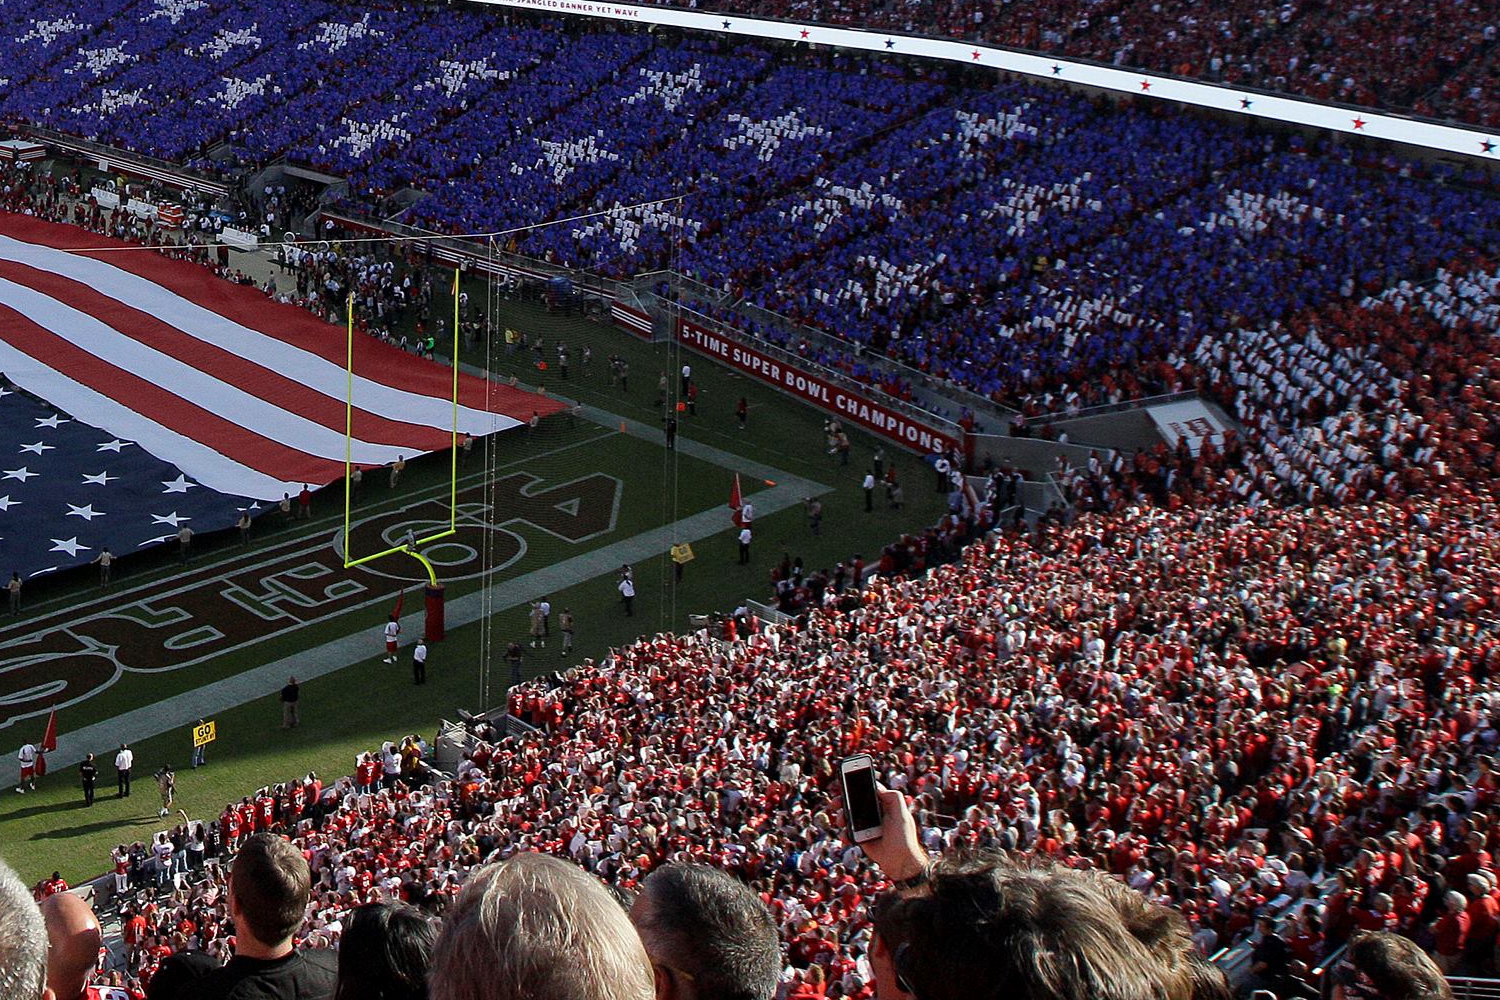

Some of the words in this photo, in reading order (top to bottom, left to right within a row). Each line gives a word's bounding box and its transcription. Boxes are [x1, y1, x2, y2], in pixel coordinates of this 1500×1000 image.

[560, 1, 593, 12] BANNER
[595, 6, 611, 14] YET
[614, 8, 639, 17] WAVE
[682, 324, 729, 357] 5-TIME
[733, 348, 780, 381] SUPER
[785, 371, 830, 404] BOWL
[835, 394, 944, 454] CHAMPIONS
[198, 725, 211, 737] GO
